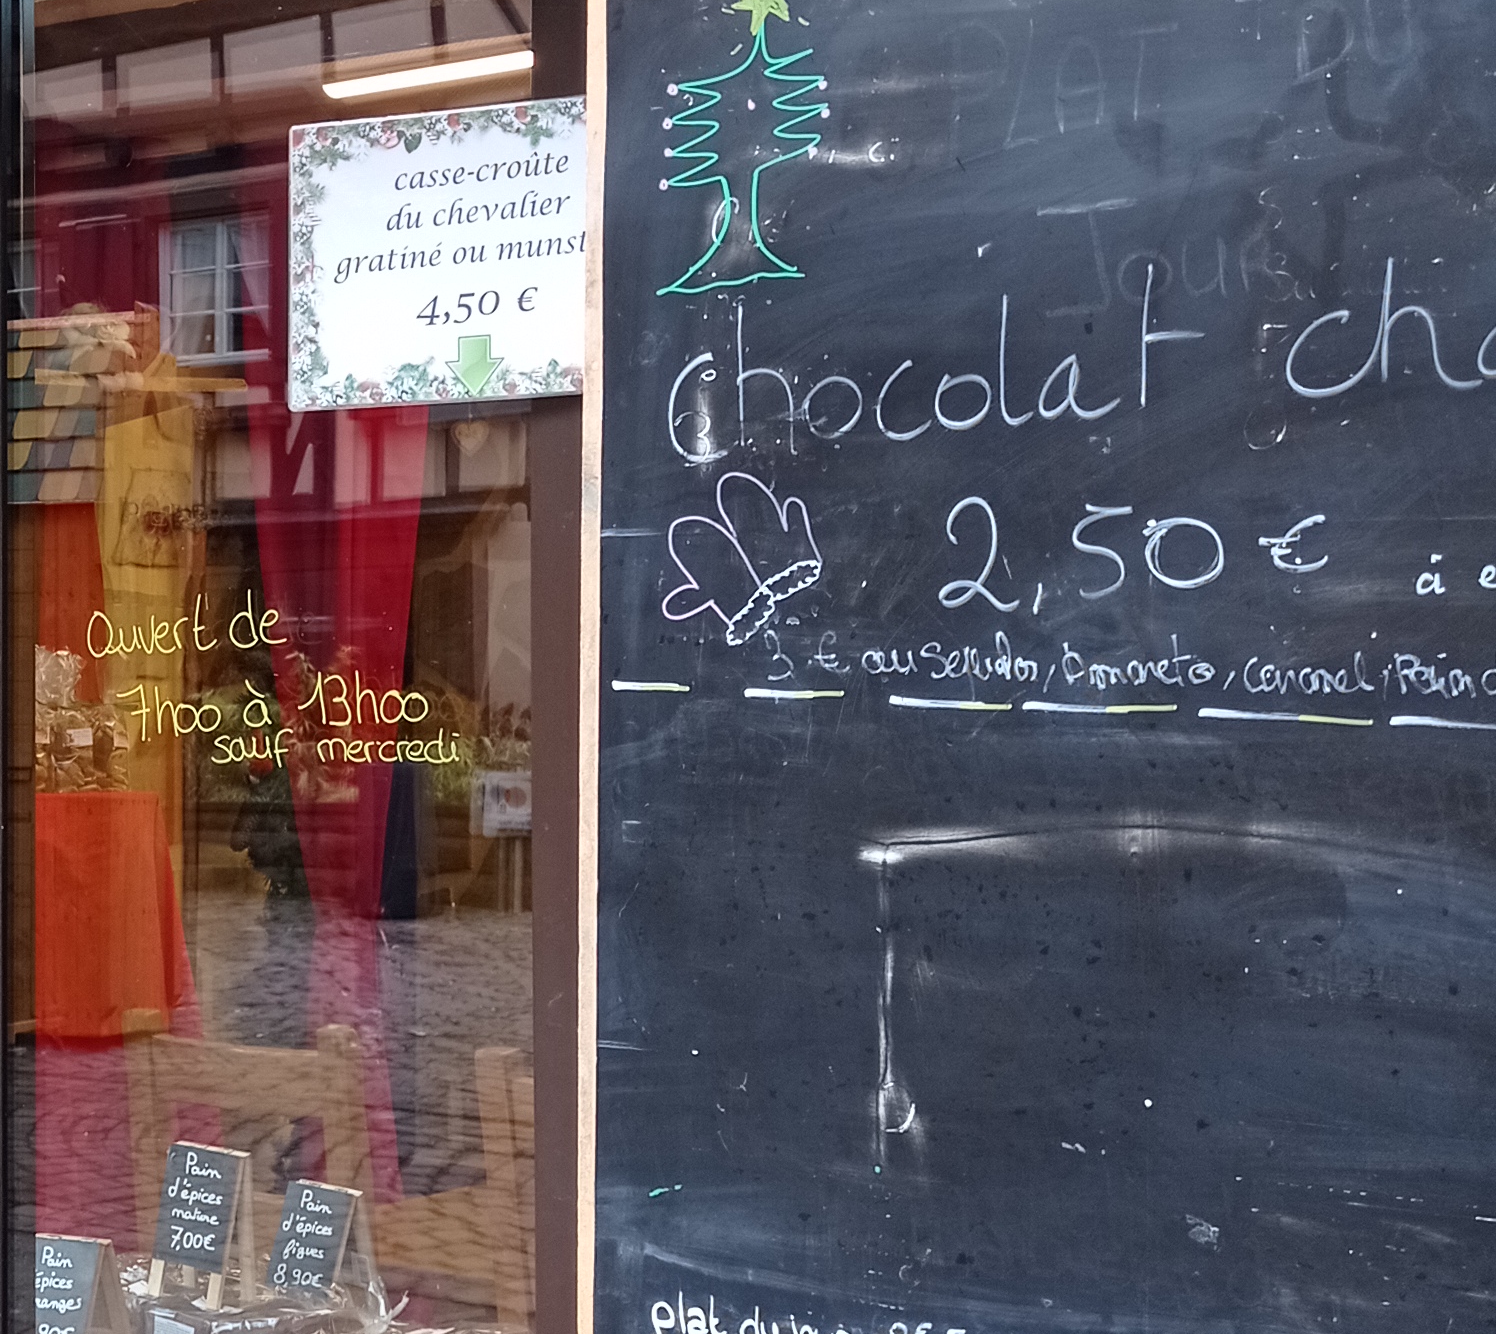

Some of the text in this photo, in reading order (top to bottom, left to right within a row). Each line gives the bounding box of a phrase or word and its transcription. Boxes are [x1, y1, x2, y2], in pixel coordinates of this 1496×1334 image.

[393, 150, 571, 192] casse-croûte
[385, 189, 572, 232] du chevalier
[333, 240, 443, 285] gratiné
[453, 244, 488, 266] ou
[415, 285, 539, 327] 4,50 €
[938, 495, 1226, 615] 2,50
[1259, 514, 1330, 573] €
[86, 589, 288, 660] Ouvert de
[242, 679, 273, 728] à
[210, 727, 463, 768] sauf mercredi
[185, 1151, 222, 1179] Pain
[167, 1176, 224, 1206] d'épices
[300, 1189, 333, 1214] Pain
[281, 1212, 333, 1238] d'épices
[41, 1245, 73, 1268] Pain
[282, 1238, 325, 1260] figues
